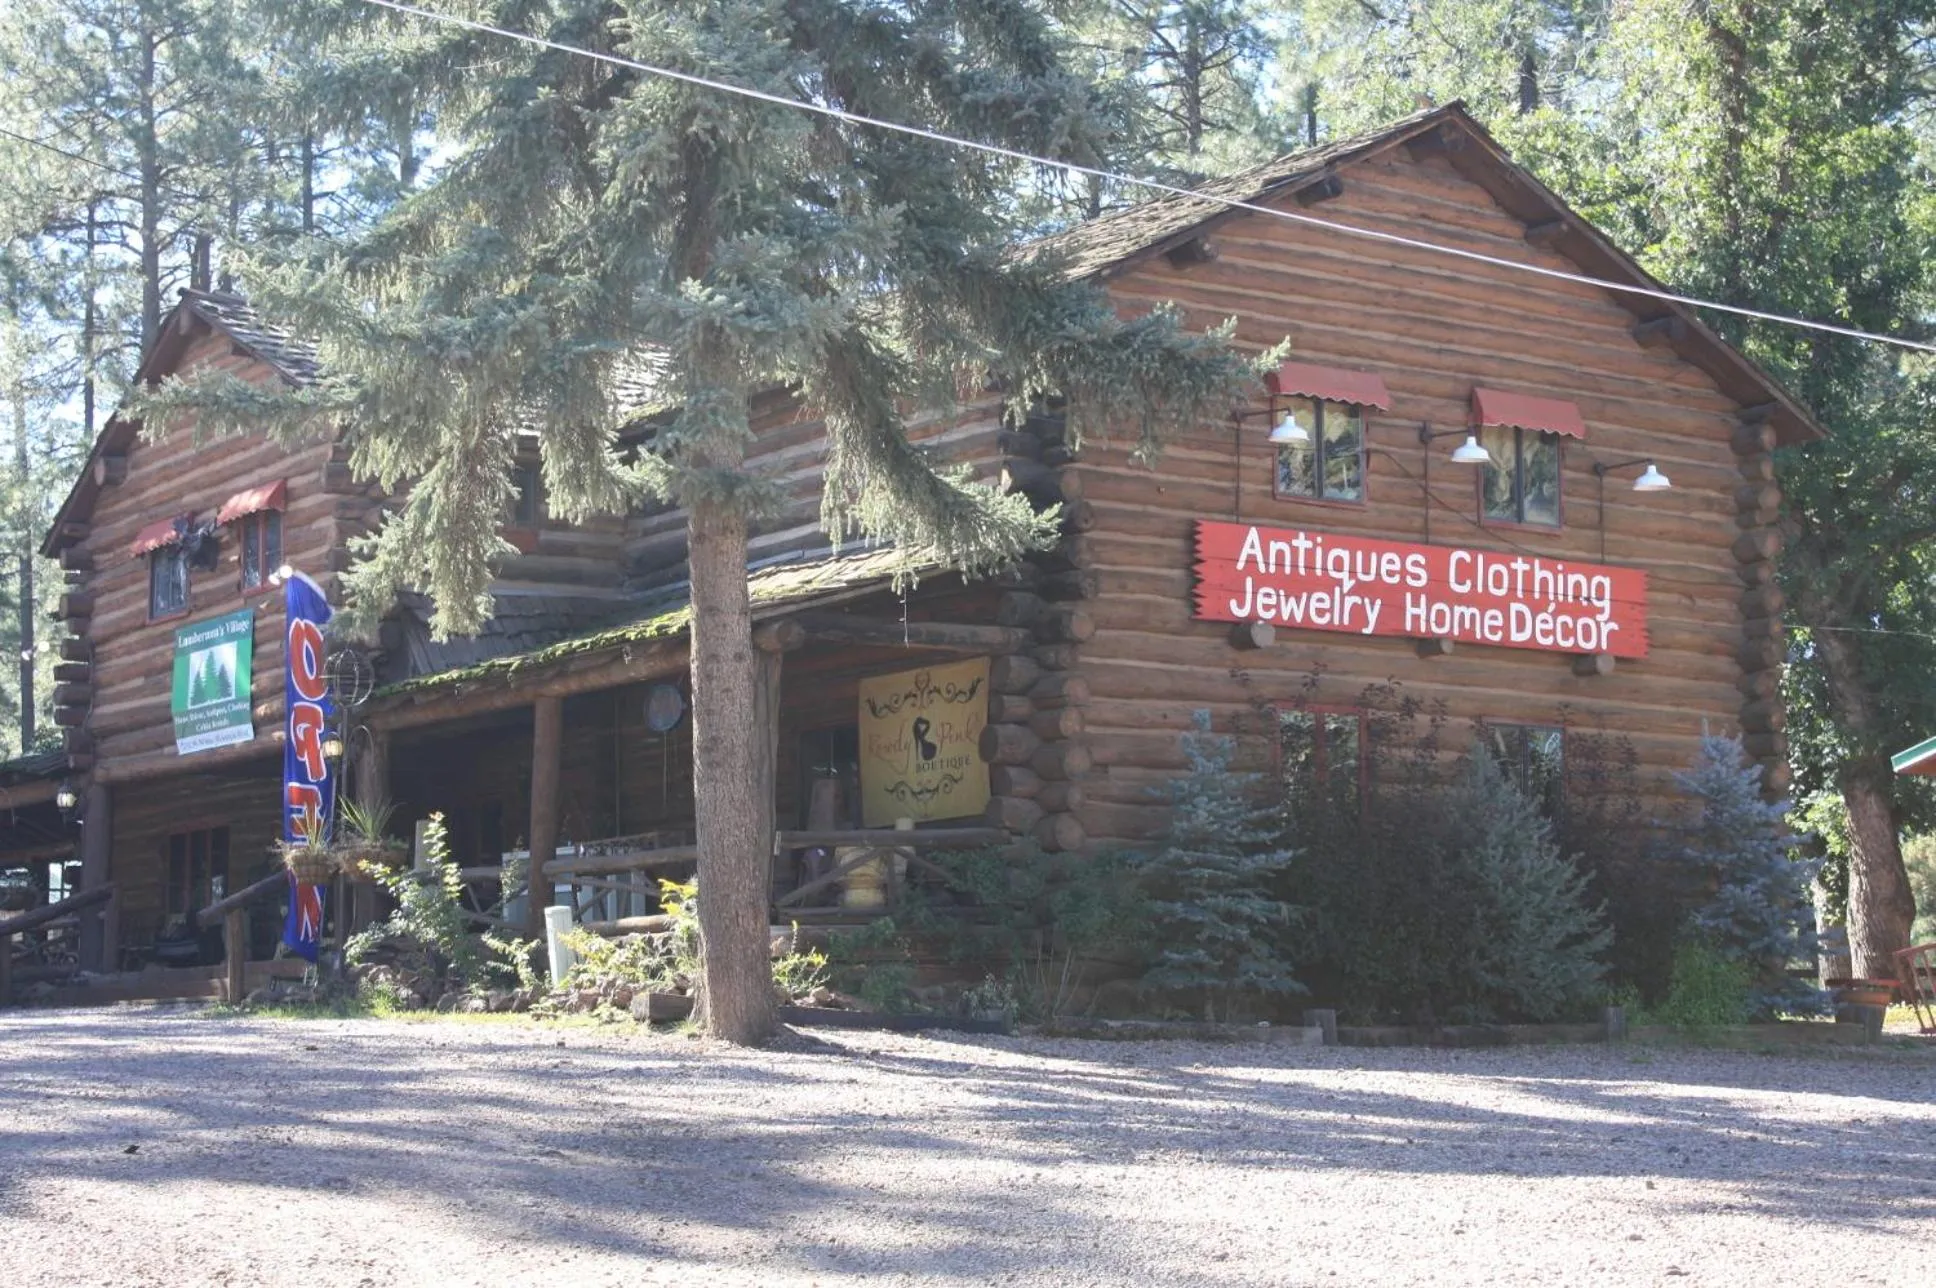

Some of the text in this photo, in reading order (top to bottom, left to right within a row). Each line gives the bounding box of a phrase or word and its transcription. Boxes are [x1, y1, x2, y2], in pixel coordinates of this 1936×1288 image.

[1236, 526, 1611, 622] Antiques Clothing
[1229, 576, 1619, 650] Jewelry Home Décor
[916, 754, 972, 772] BOUTIQUE
